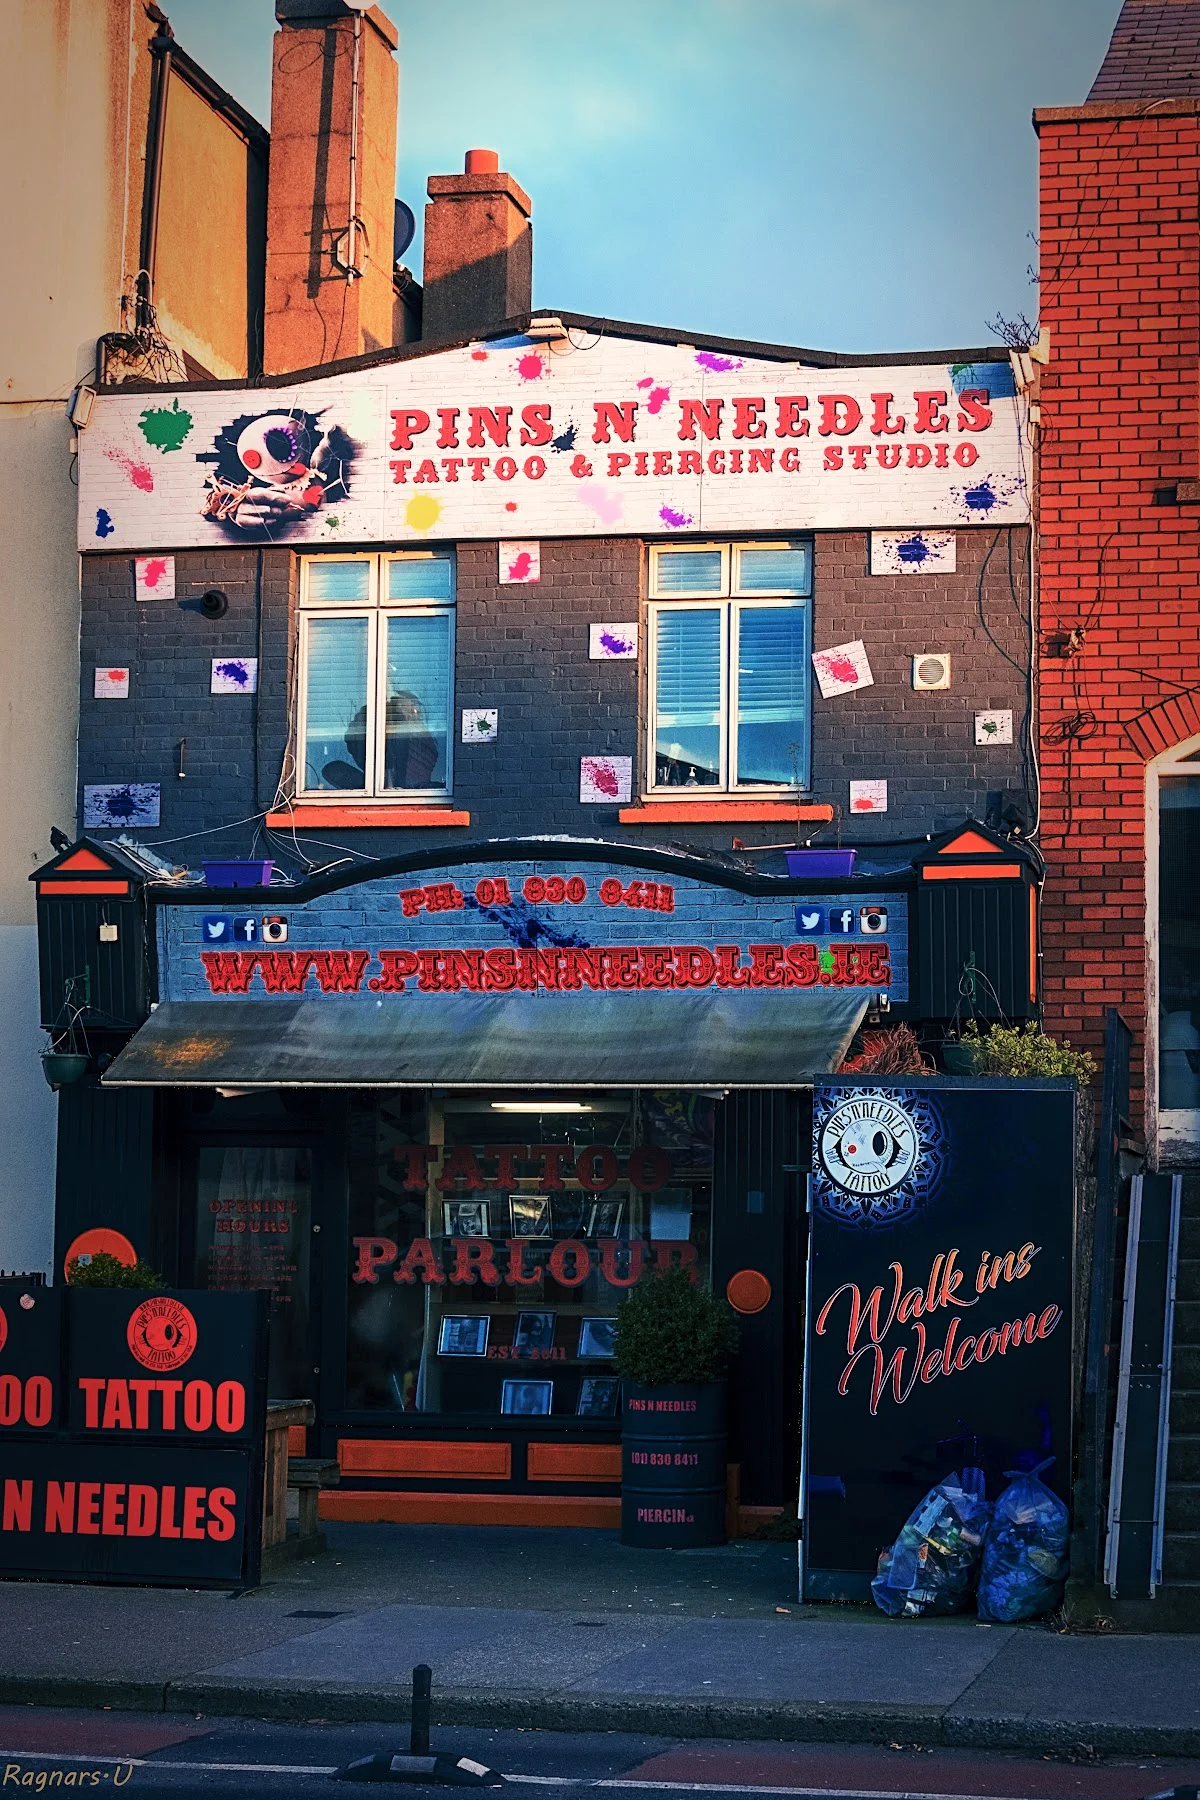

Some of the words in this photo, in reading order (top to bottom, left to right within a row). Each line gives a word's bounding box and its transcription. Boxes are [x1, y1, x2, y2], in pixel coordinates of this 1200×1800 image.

[389, 403, 554, 450] PINS
[592, 401, 639, 444] N
[677, 388, 993, 441] NEEDLES
[389, 455, 548, 484] TATTOO
[569, 454, 593, 478] &
[607, 446, 801, 478] PIERCING
[823, 441, 980, 471] STUDIO
[399, 881, 465, 919] PH:
[474, 877, 512, 907] 01
[521, 875, 587, 905] 830
[599, 876, 676, 915] 8411
[200, 943, 892, 994] WWW.PINSNNEEDLES.IE
[395, 1143, 676, 1192] TATTOO
[843, 1170, 891, 1192] TATTOO
[216, 1219, 289, 1233] HOURS
[351, 1236, 700, 1288] PARLOUR
[816, 1248, 980, 1355] Walk
[976, 1241, 1042, 1293] ins
[147, 1349, 176, 1362] TATTOO
[838, 1303, 1063, 1415] Welcome
[78, 1377, 246, 1433] TATTOO
[647, 1399, 655, 1411] N
[656, 1400, 697, 1412] NEEDLES
[650, 1453, 671, 1465] 830
[674, 1453, 699, 1466] 8411
[2, 1479, 34, 1532] N
[45, 1480, 237, 1542] NEEDLES
